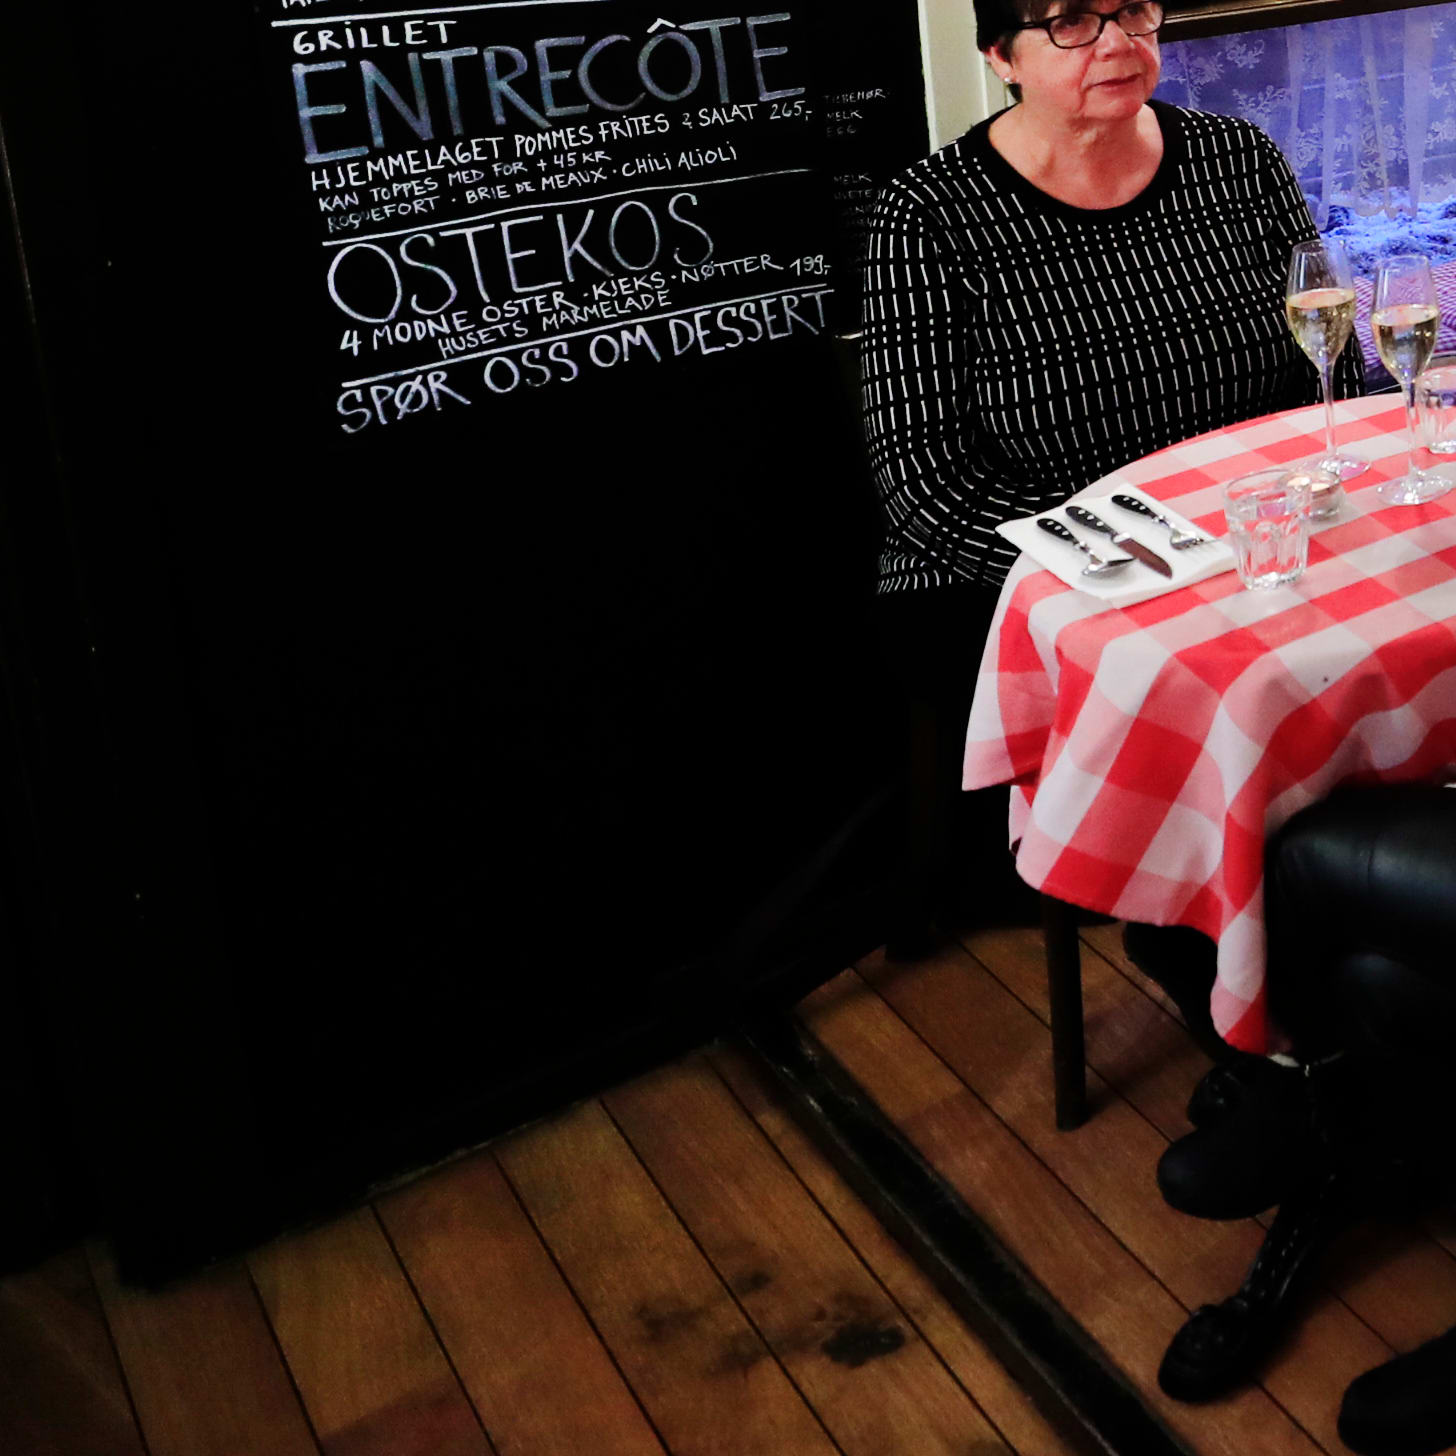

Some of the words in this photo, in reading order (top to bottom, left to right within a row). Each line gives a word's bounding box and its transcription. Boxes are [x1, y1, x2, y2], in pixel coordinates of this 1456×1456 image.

[291, 12, 806, 165] ENTRECÔTE
[292, 21, 457, 56] GRILLET
[327, 192, 715, 324] OSTEKOS
[336, 369, 471, 435] SPØR
[483, 341, 579, 394] OSS
[588, 325, 662, 368] OM
[668, 288, 835, 358] DESSERT
